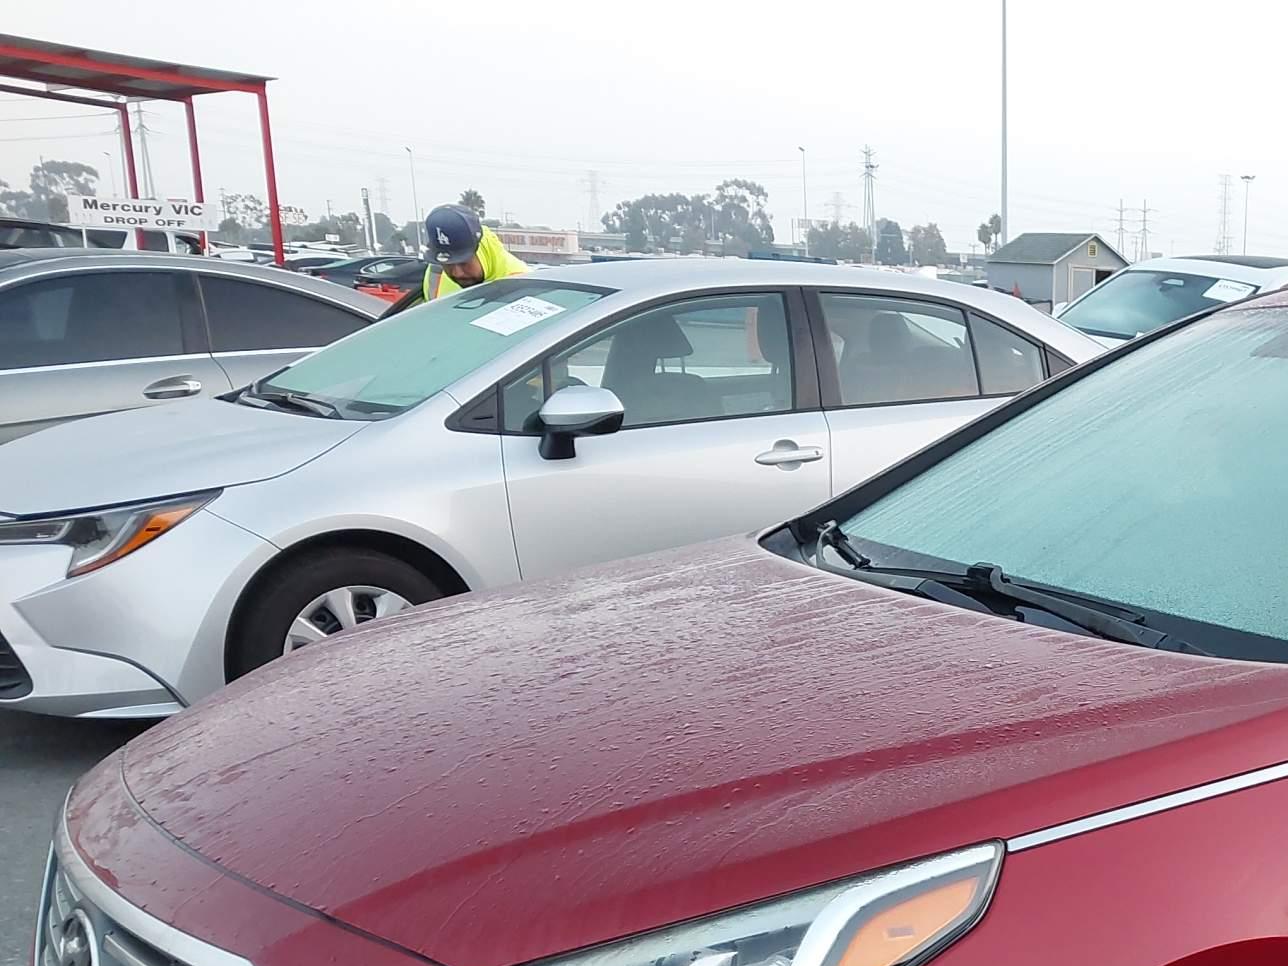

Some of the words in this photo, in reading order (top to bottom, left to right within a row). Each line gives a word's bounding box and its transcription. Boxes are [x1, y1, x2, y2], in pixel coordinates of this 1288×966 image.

[82, 198, 163, 216] Mercury
[172, 204, 203, 217] VIC
[103, 215, 148, 226] DROP
[154, 218, 186, 228] OFF
[436, 226, 450, 245] LA
